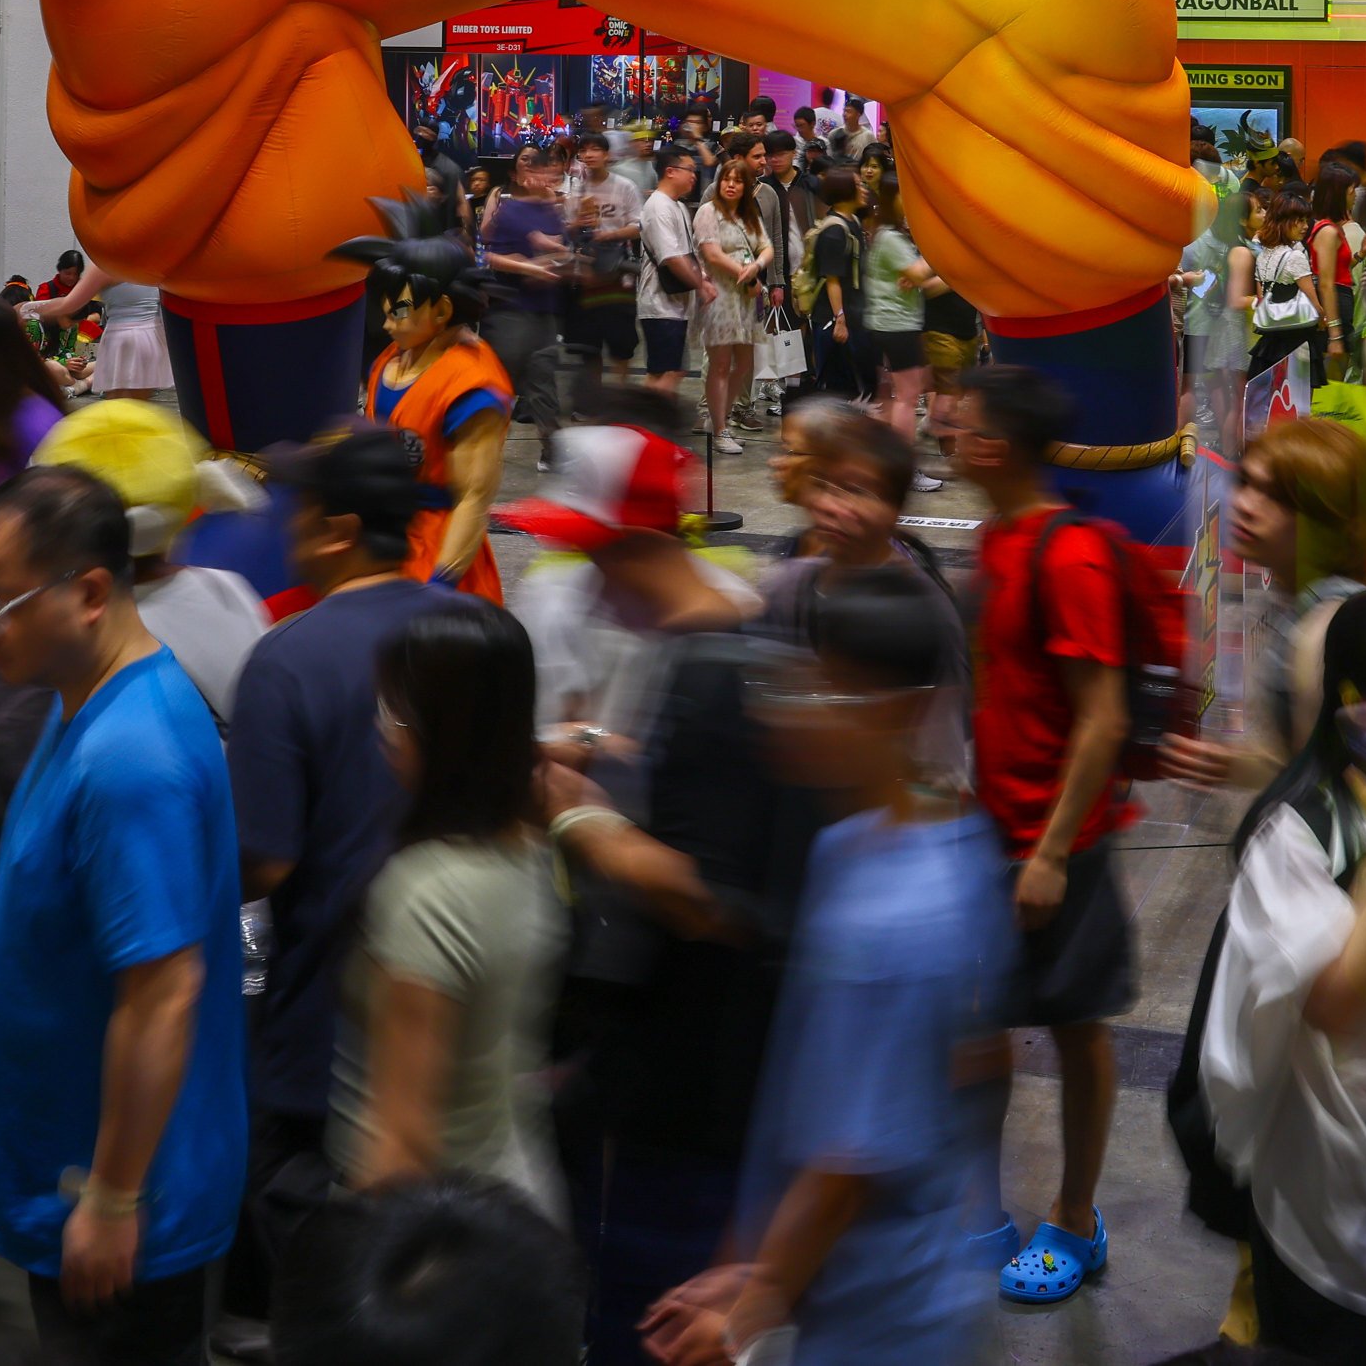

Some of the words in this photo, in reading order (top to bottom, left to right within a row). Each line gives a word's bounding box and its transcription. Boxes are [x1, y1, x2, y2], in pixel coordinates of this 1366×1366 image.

[452, 25, 479, 34] EMBER
[480, 25, 500, 34] TOYS
[501, 26, 533, 35] LIMITED
[607, 28, 624, 37] CON
[1188, 74, 1228, 85] MING
[1233, 74, 1279, 86] SOON
